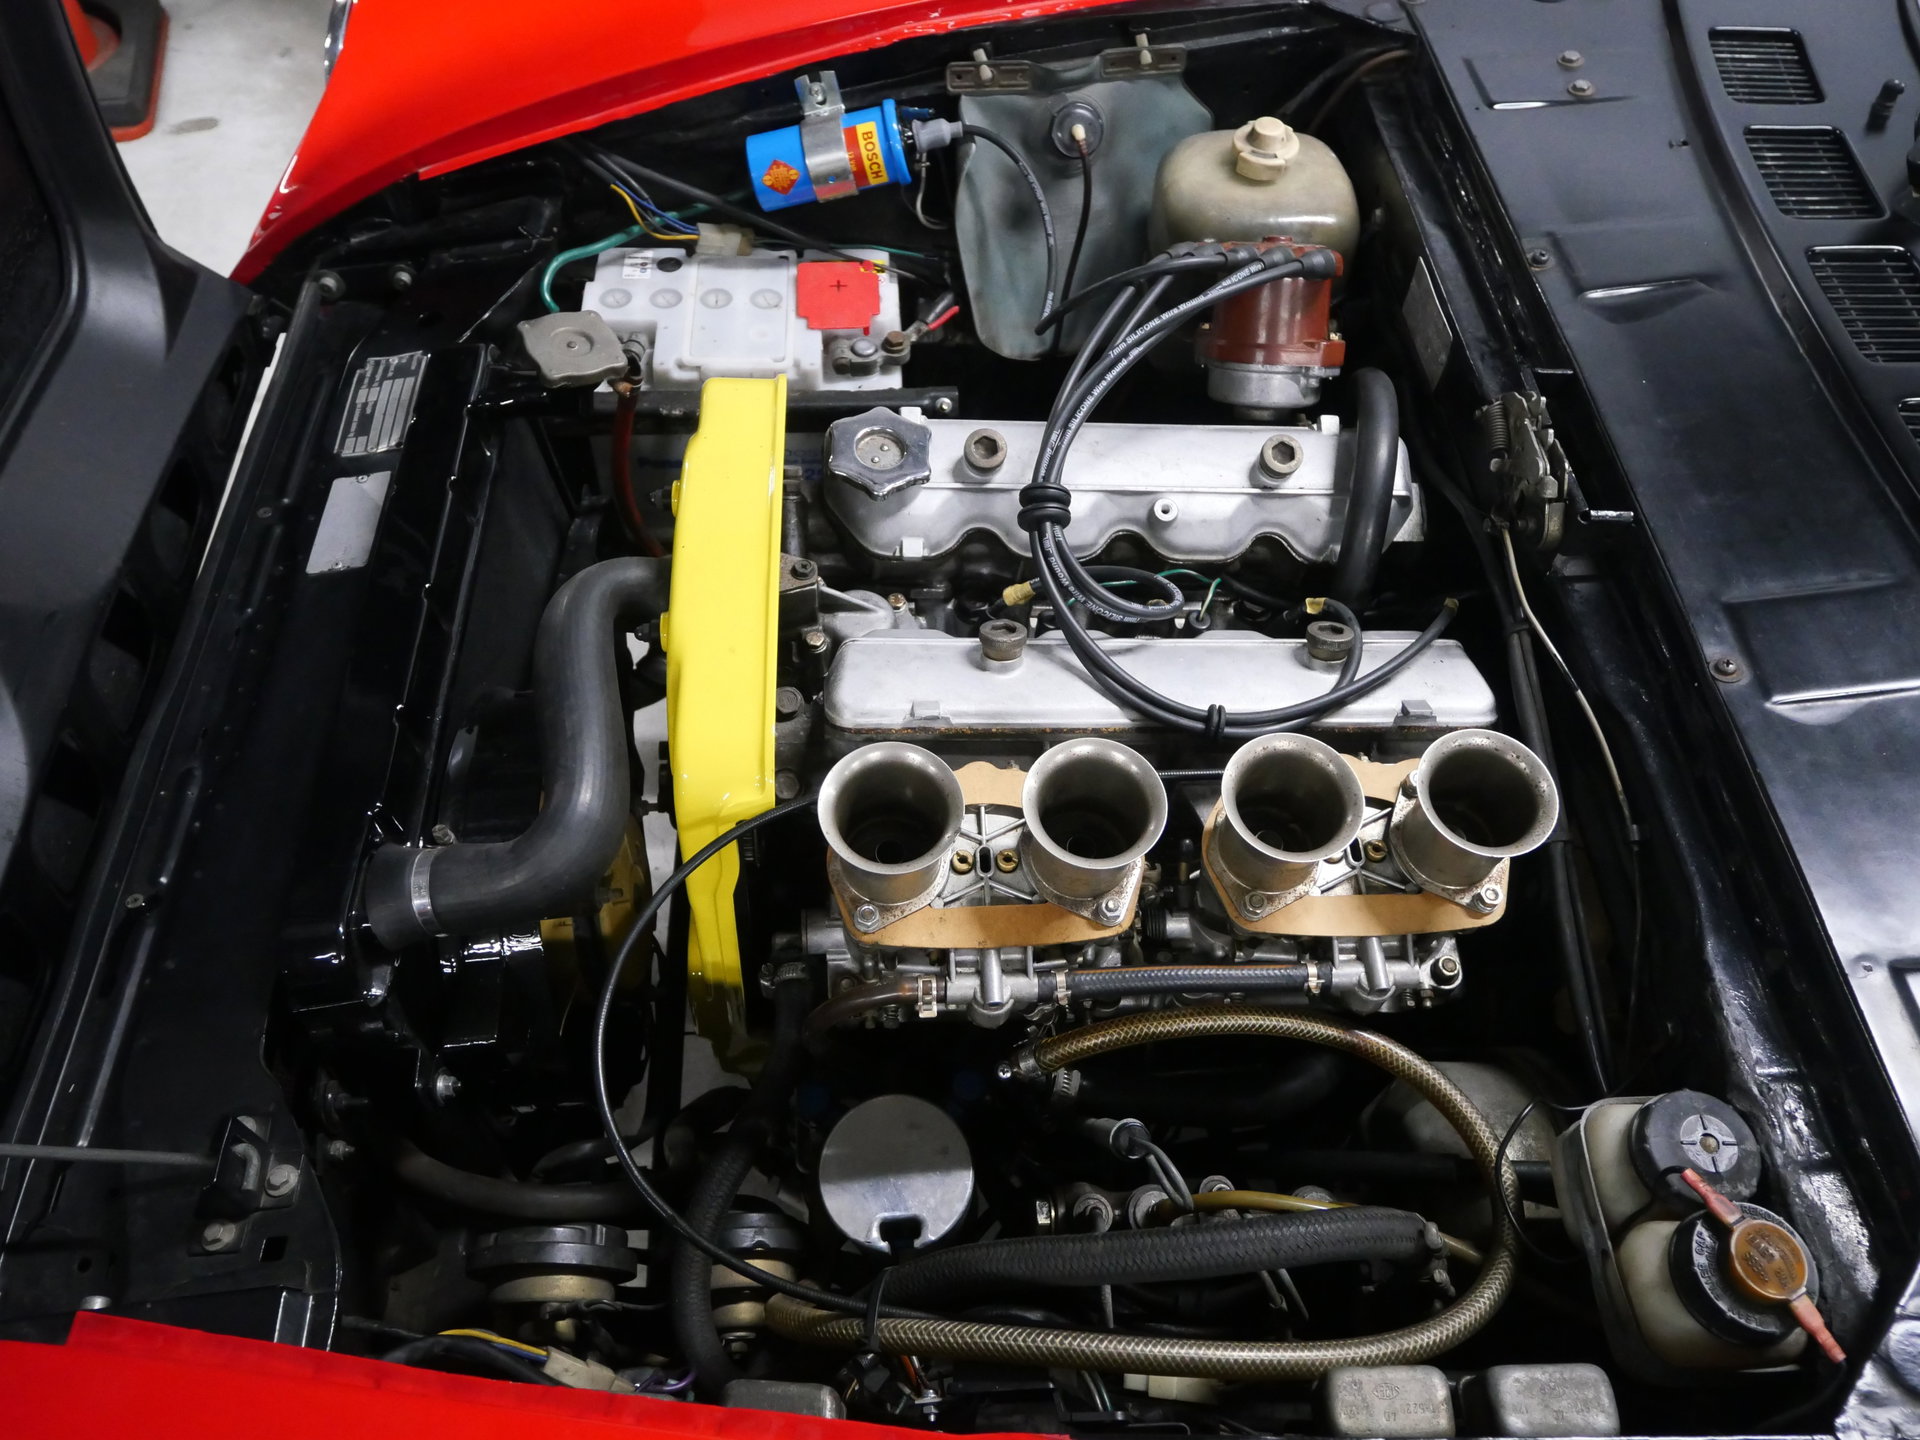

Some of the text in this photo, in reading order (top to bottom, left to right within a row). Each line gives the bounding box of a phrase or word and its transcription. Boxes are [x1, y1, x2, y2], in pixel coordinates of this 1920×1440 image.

[861, 130, 883, 180] BOSCH
[1108, 341, 1127, 358] 7mm
[1126, 317, 1161, 344] SILICONE
[1160, 307, 1179, 321] Wire
[1178, 294, 1205, 312] Wound
[1068, 394, 1095, 429] SILICONE
[1091, 379, 1107, 396] Wire
[1104, 357, 1128, 381] Wound
[1050, 556, 1069, 587] Wound
[1068, 585, 1086, 604] Wire
[1085, 601, 1124, 622] SILICONE
